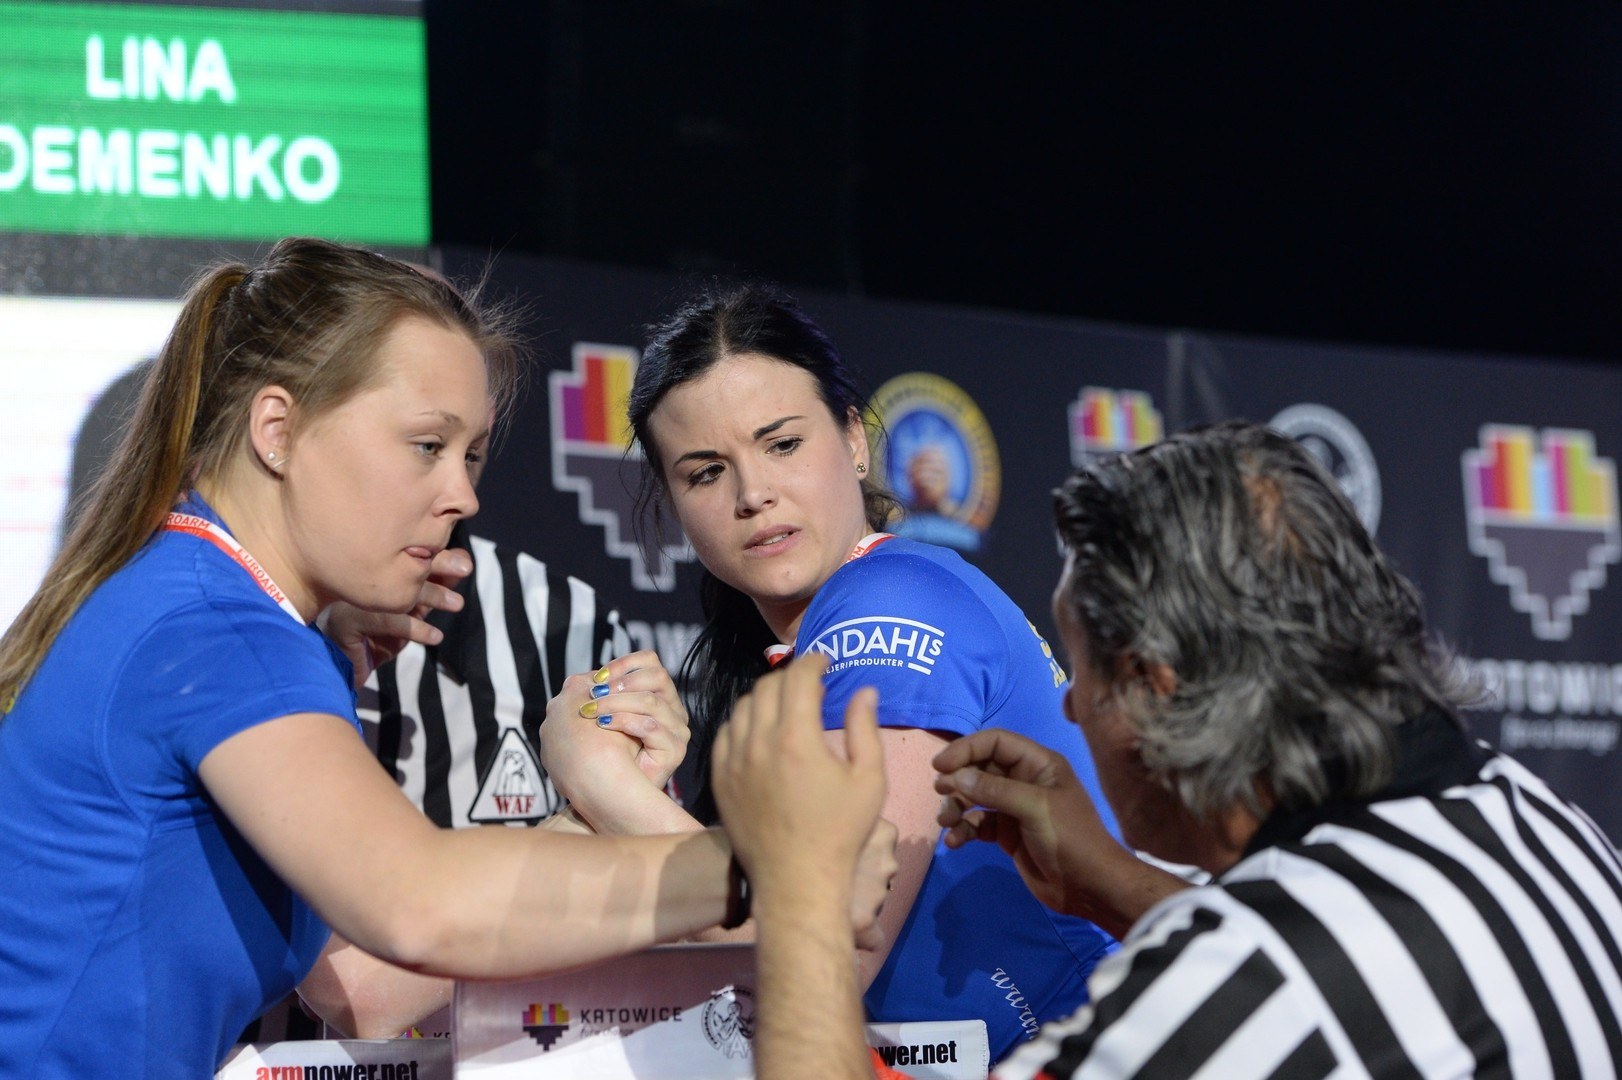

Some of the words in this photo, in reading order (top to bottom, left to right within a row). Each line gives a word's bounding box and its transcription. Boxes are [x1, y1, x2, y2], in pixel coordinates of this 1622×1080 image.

[86, 34, 238, 104] LINA
[821, 658, 904, 675] EJERIPRODUKTER
[492, 795, 537, 815] WAF
[580, 1007, 683, 1024] KATOWICE
